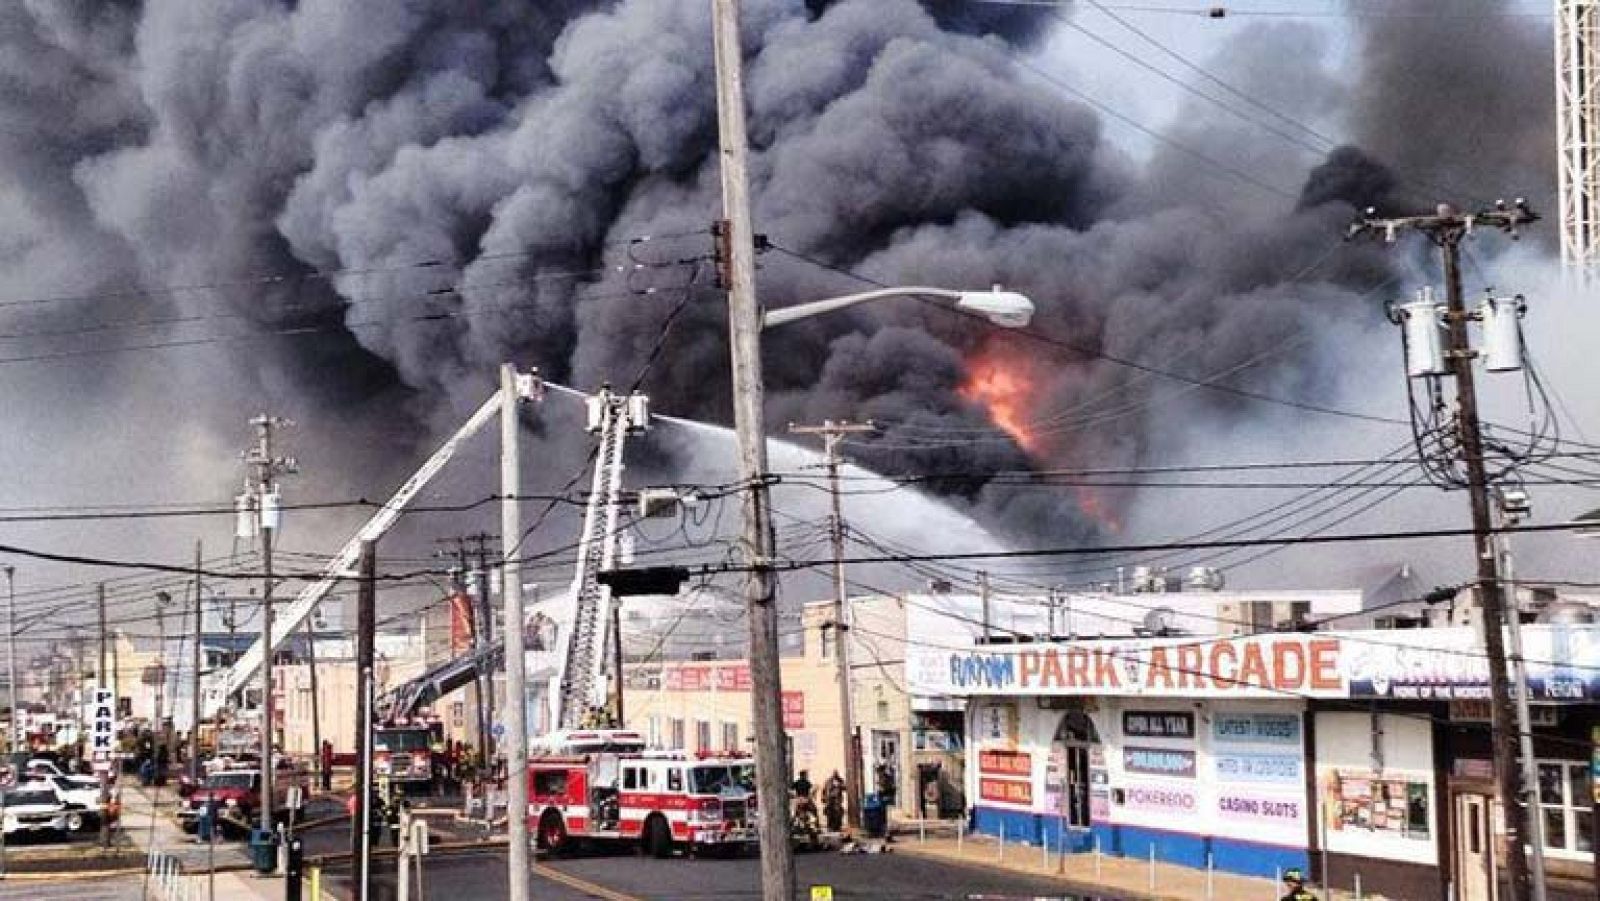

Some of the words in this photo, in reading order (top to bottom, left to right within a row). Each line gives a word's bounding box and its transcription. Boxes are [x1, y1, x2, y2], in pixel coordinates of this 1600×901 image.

[1019, 647, 1121, 688] PARK
[1146, 639, 1342, 689] ARCADE
[96, 692, 111, 747] PARK
[1219, 796, 1259, 815] CASINO
[1262, 800, 1298, 819] SLOTS
